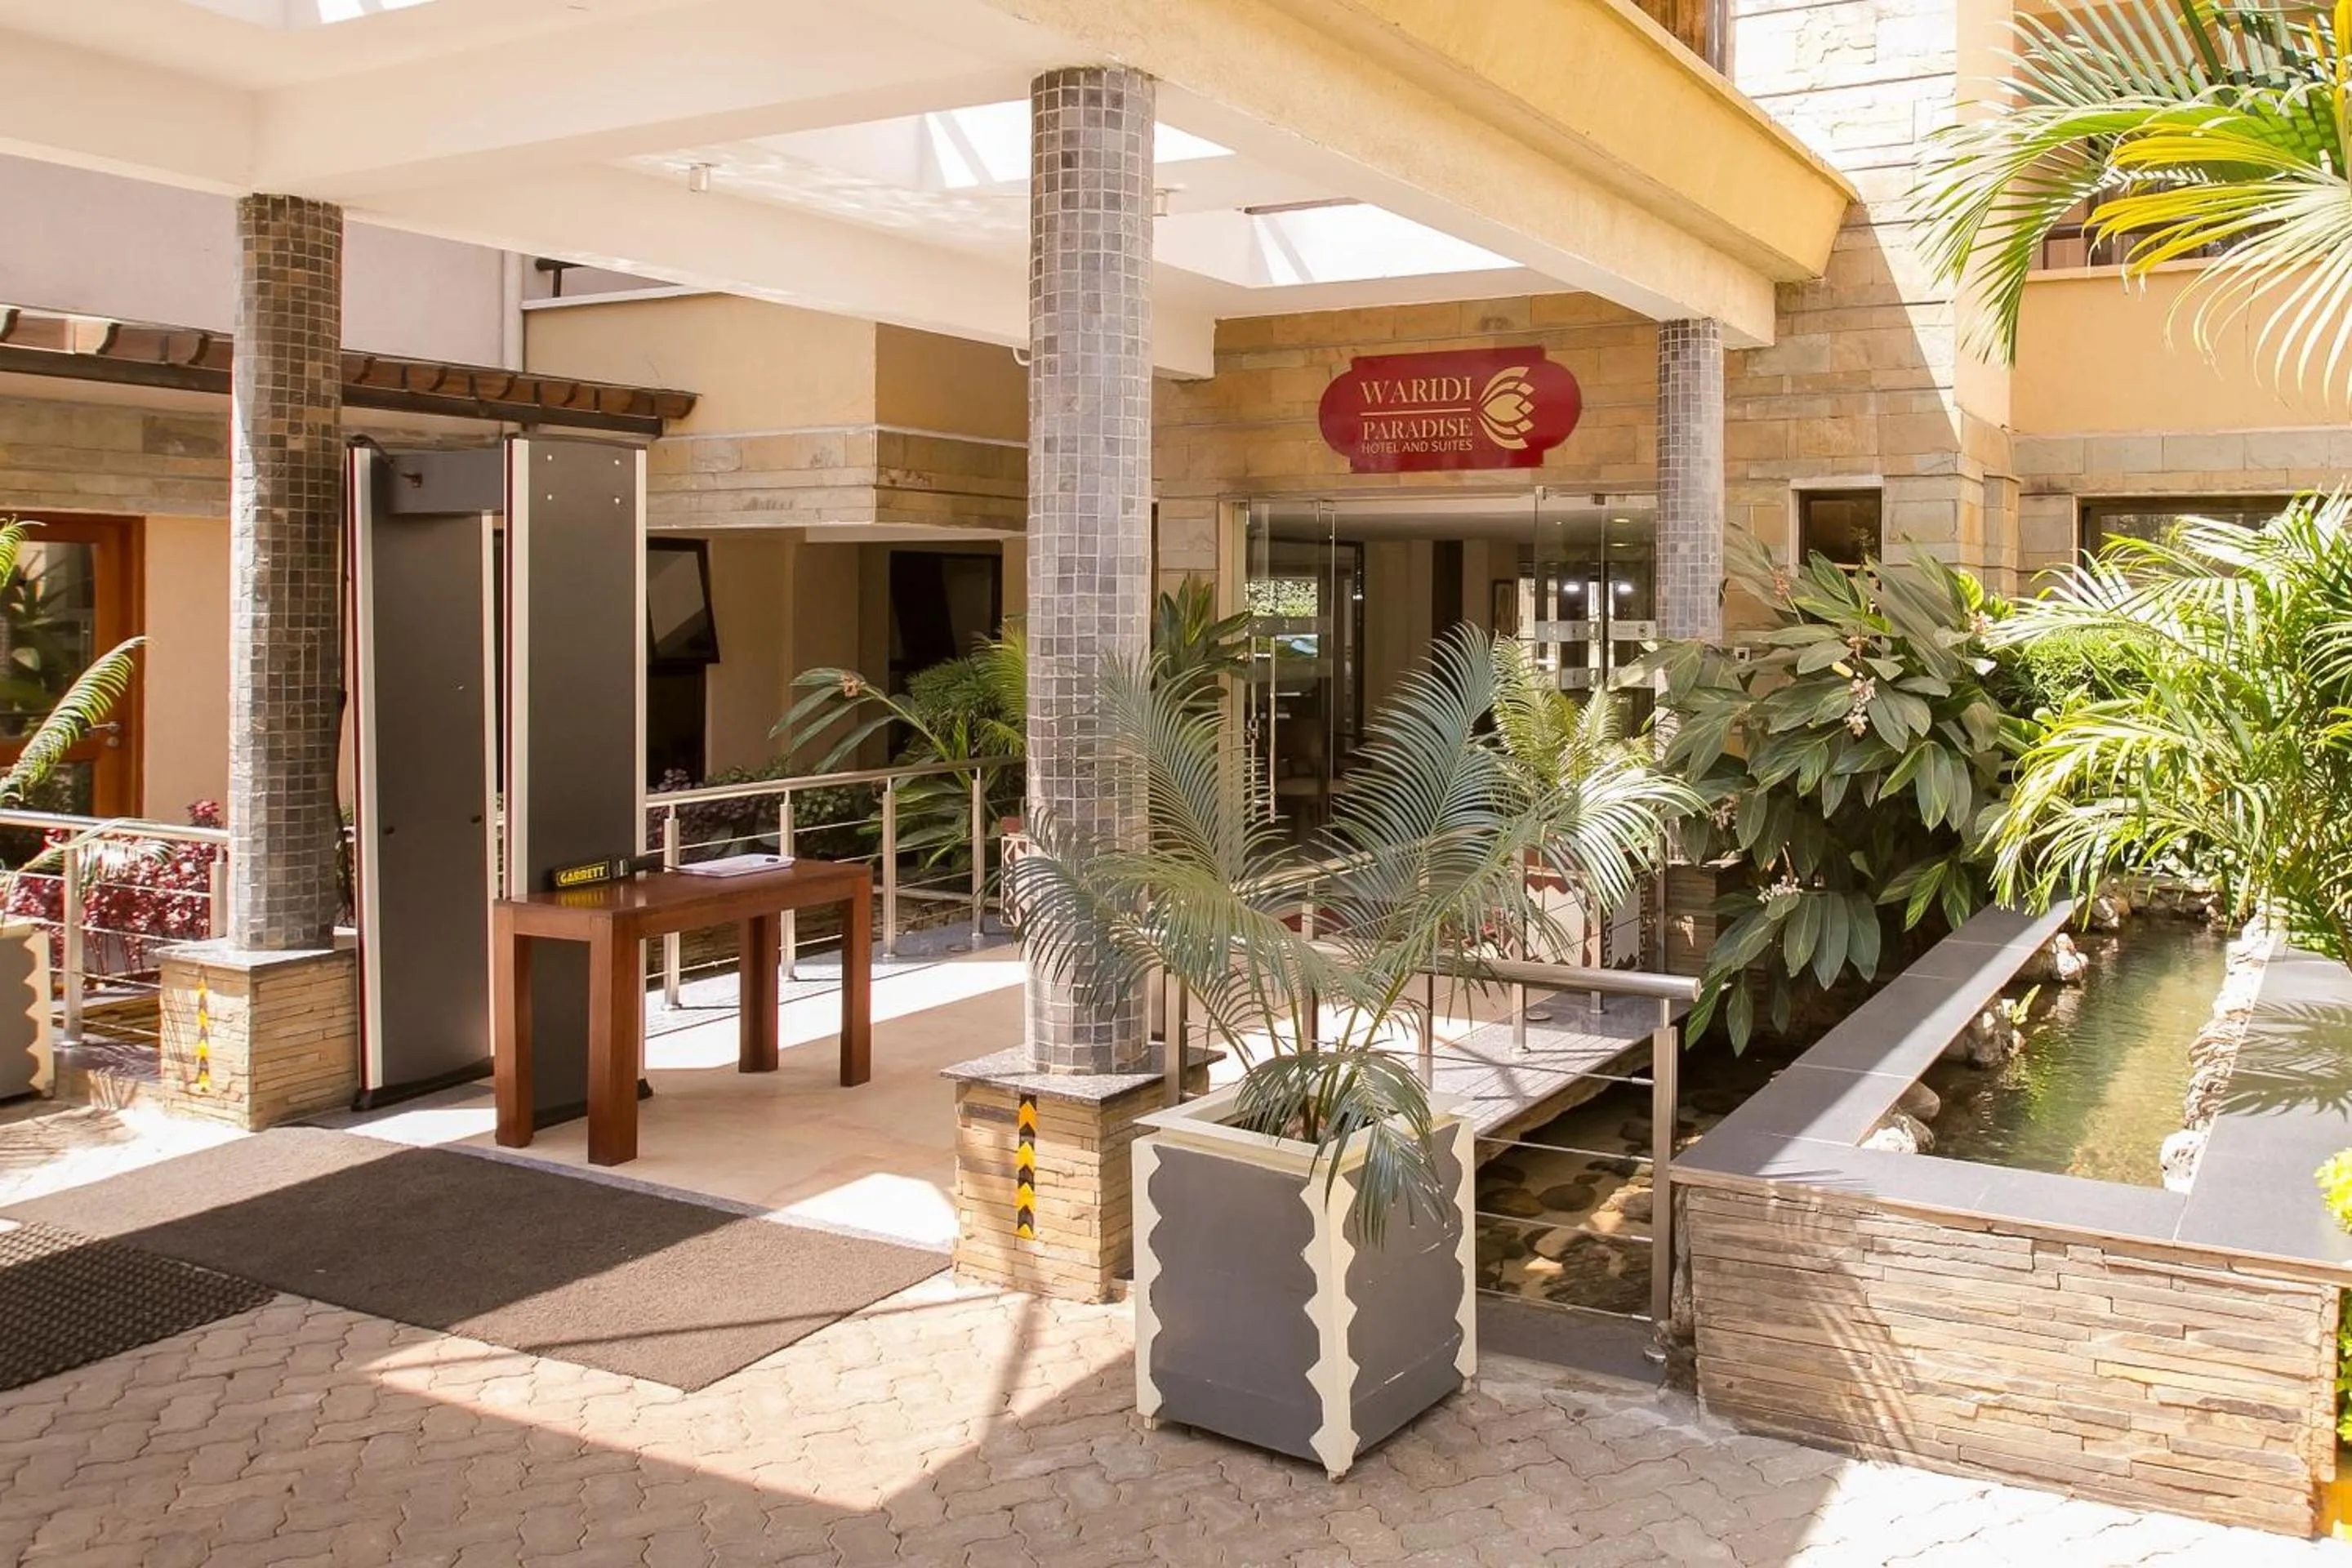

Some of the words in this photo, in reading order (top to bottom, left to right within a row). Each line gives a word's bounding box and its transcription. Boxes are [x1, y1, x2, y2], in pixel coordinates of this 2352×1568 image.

[1360, 376, 1472, 403] WARIDI
[1362, 417, 1472, 440] PARADISE
[1361, 442, 1400, 454] HOTEL
[1401, 441, 1428, 452] AND
[1431, 439, 1473, 452] SUITES
[560, 866, 605, 883] GARRETT
